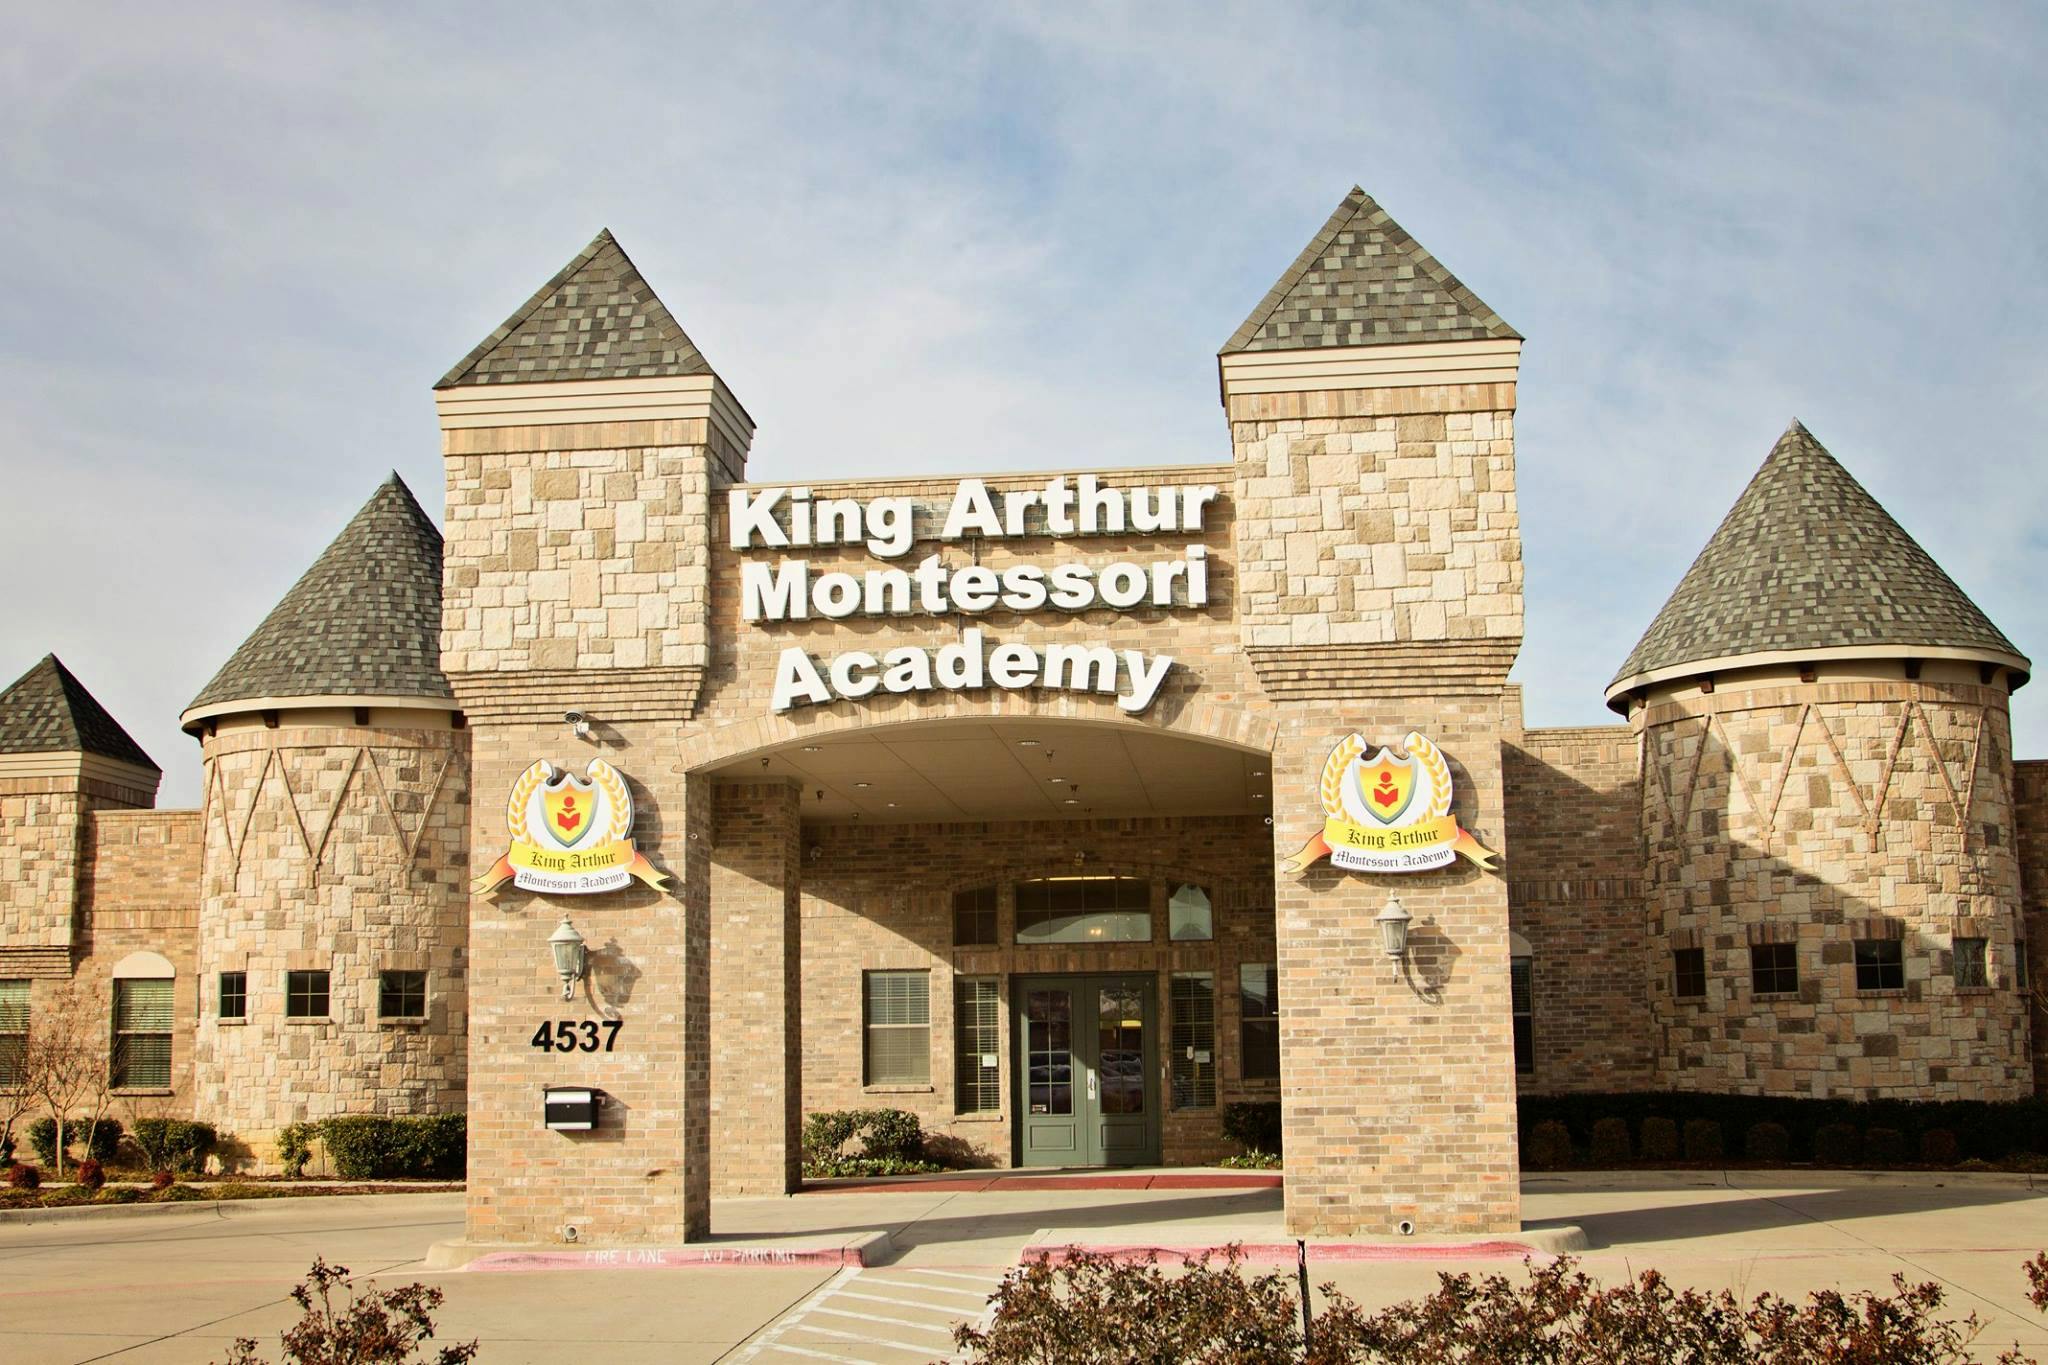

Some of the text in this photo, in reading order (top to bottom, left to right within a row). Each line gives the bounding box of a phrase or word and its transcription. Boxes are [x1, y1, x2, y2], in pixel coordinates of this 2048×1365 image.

[729, 474, 1218, 559] King Arthur
[742, 545, 1208, 620] Montessori
[771, 628, 1174, 713] Academy
[1347, 829, 1439, 849] King Arthur
[530, 851, 616, 871] King Arthur
[1335, 849, 1450, 867] Montessori Academy
[518, 872, 625, 889] Montessori Academy
[532, 1021, 624, 1052] 4537
[585, 1249, 619, 1264] FIRE
[731, 1248, 796, 1264] PARKING
